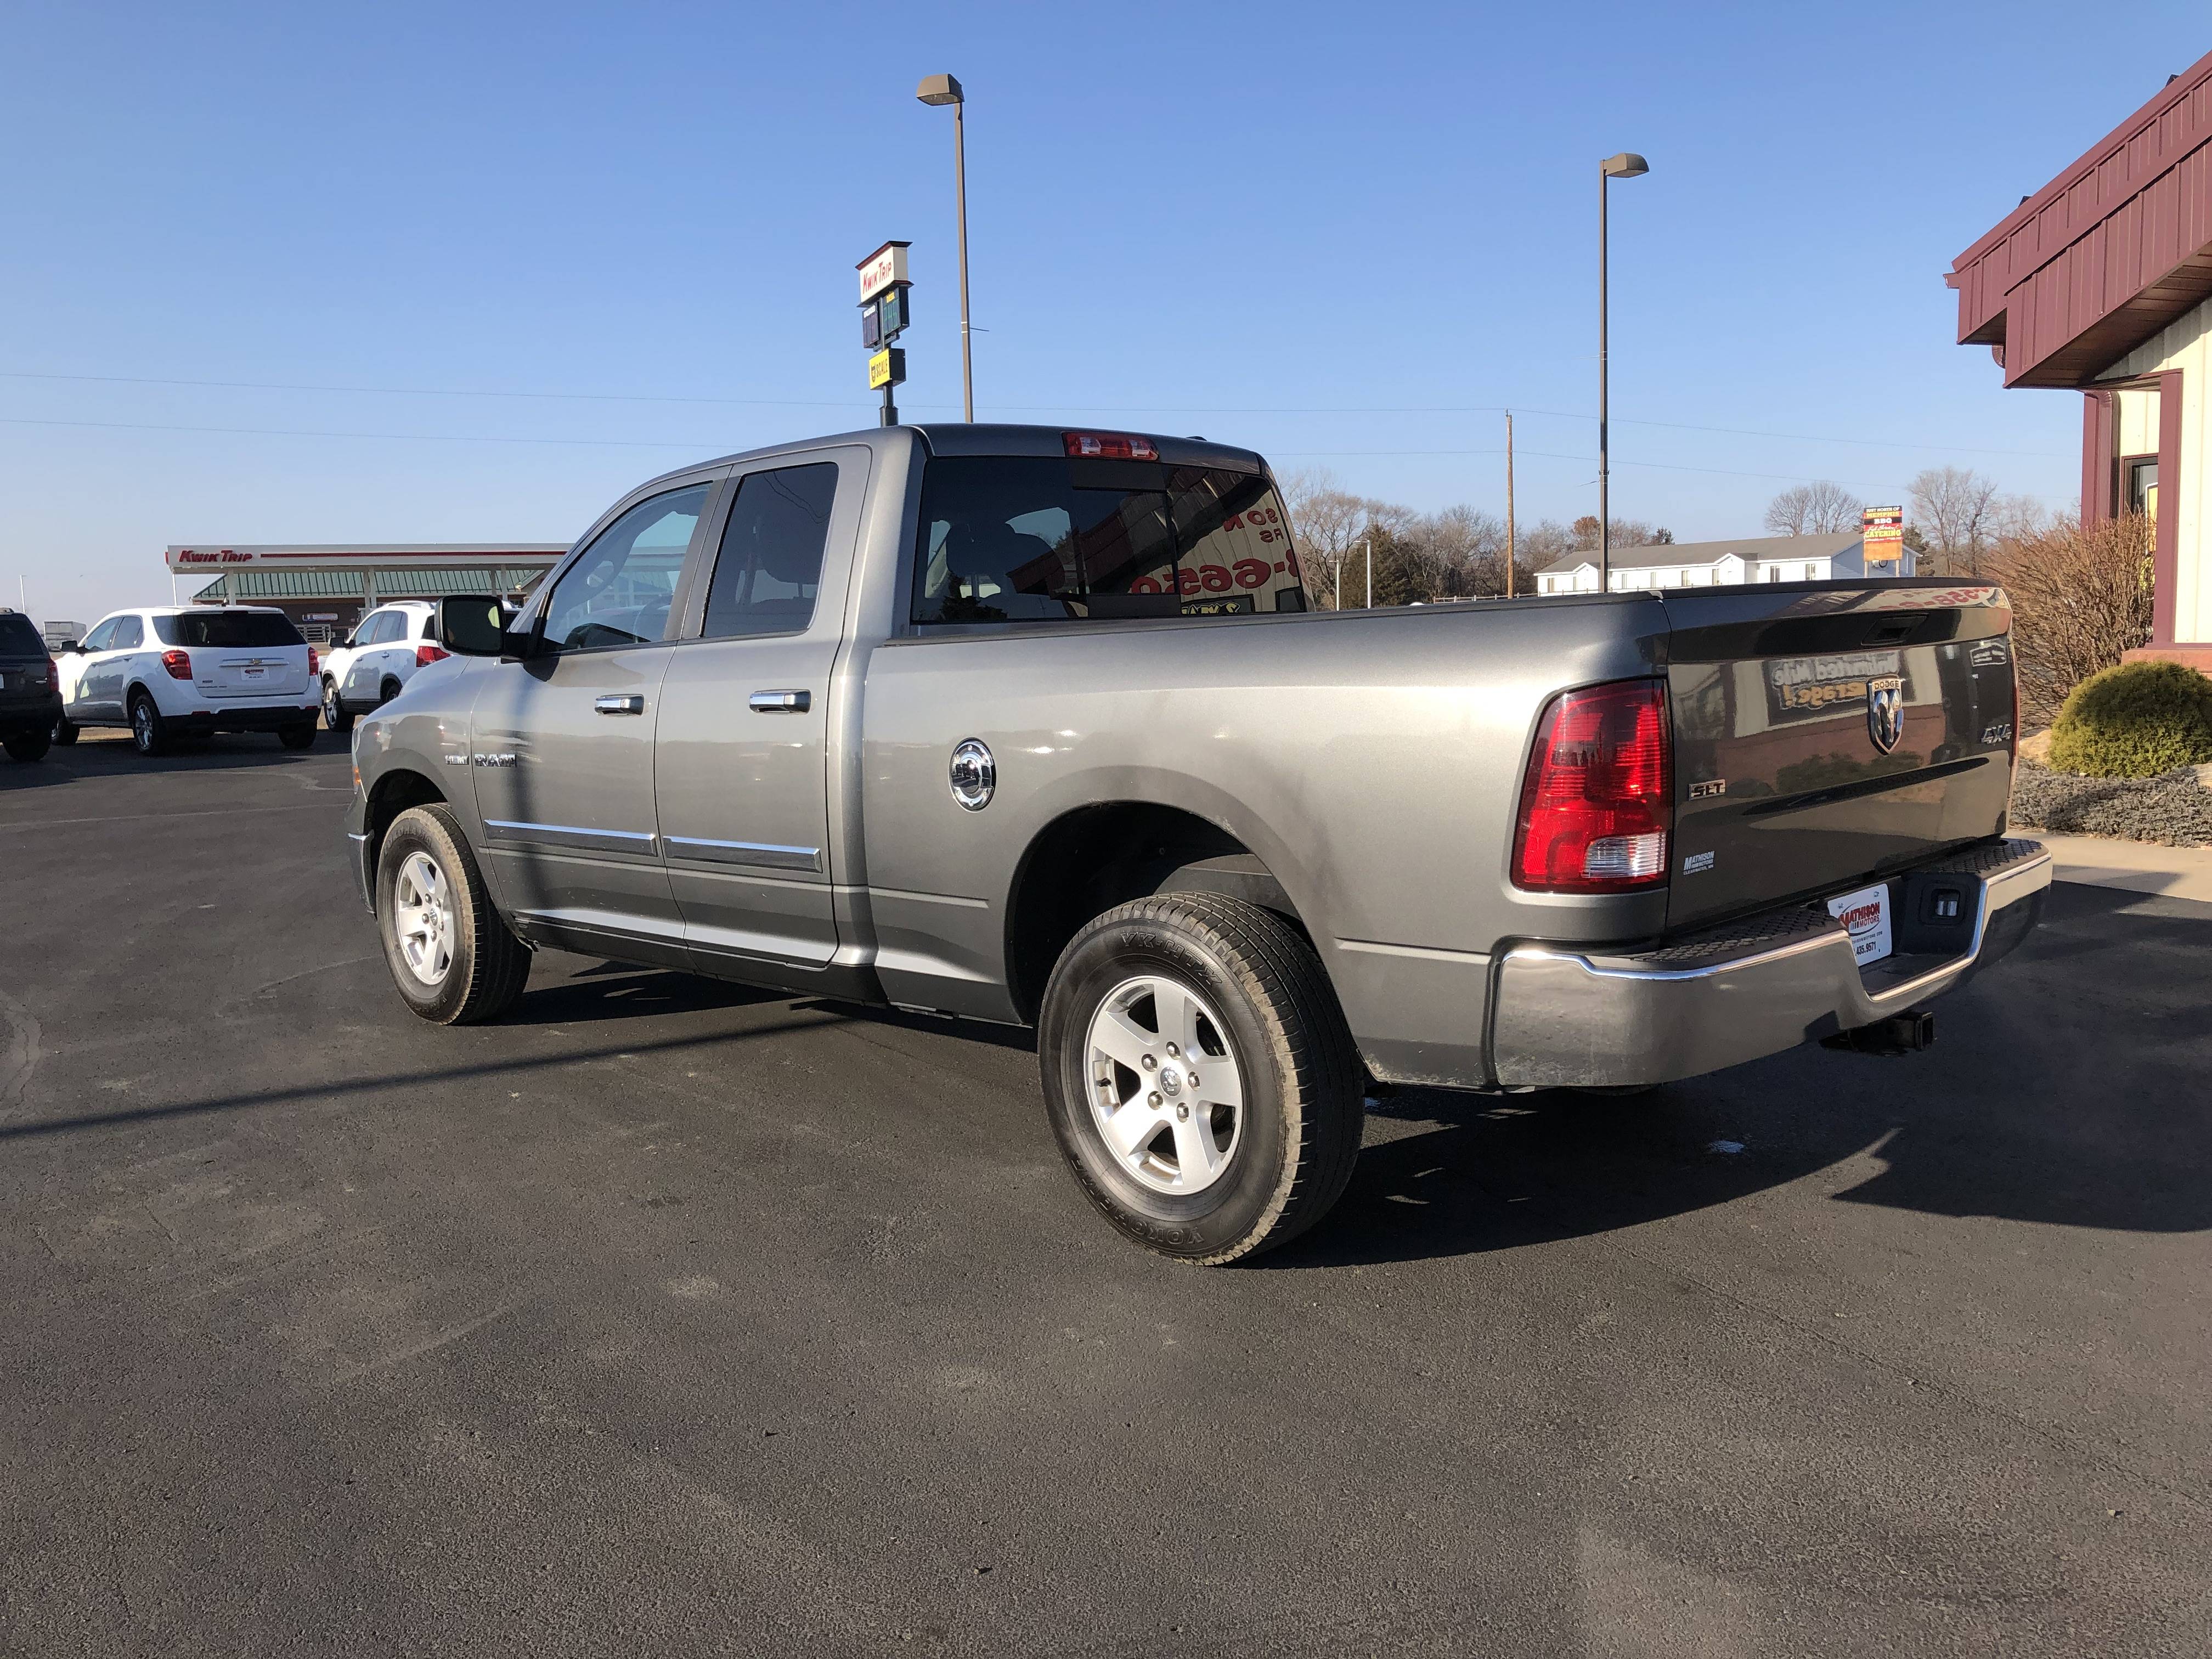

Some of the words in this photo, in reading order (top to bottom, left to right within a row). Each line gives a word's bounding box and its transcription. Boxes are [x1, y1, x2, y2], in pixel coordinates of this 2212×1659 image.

[863, 271, 878, 294] KWIK
[879, 261, 891, 283] TRIP
[876, 358, 888, 377] SCALE
[179, 550, 219, 562] KWIK
[221, 550, 253, 562] TRIP
[1874, 680, 1900, 690] DODGE
[1691, 782, 1724, 798] SLT
[1684, 851, 1715, 871] MATHISON
[1839, 901, 1881, 927] MATHISON
[1859, 915, 1880, 928] MOTORS
[1120, 932, 1223, 985] YK-HTX
